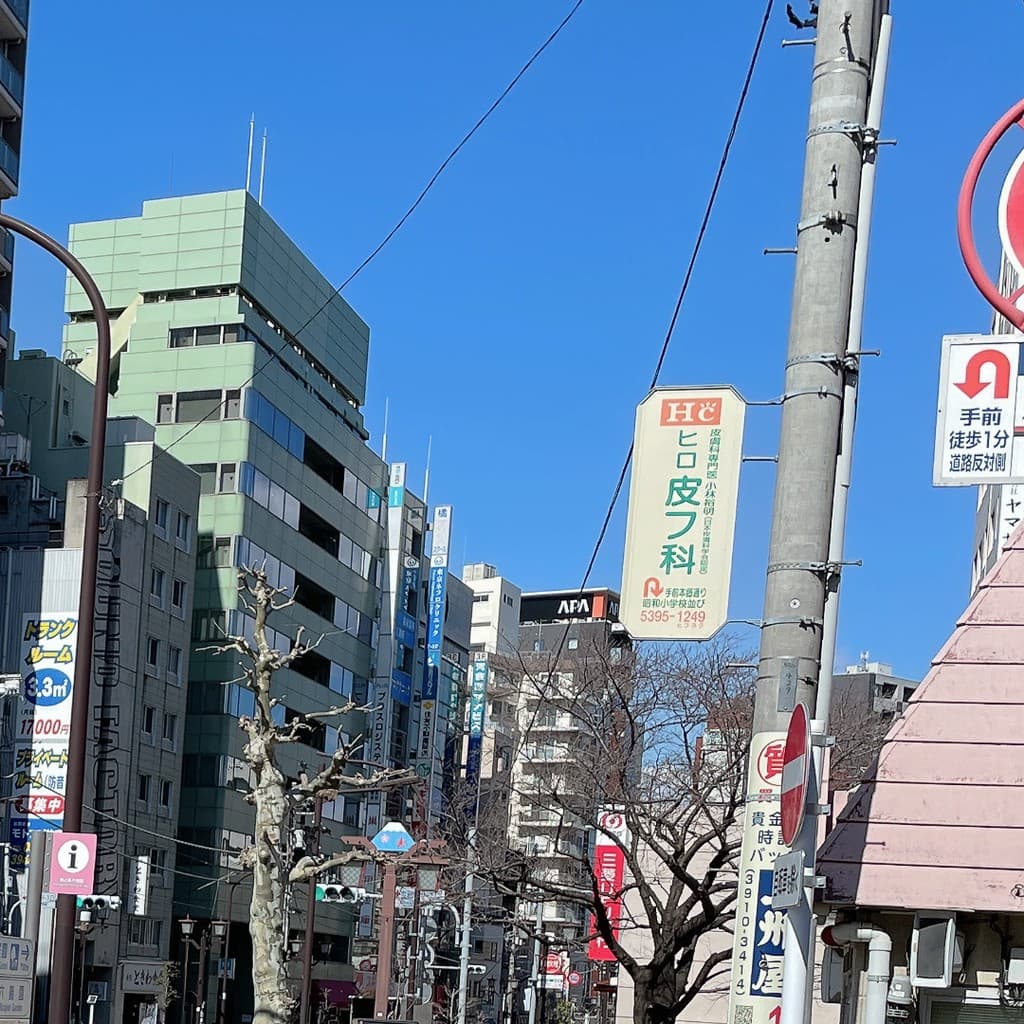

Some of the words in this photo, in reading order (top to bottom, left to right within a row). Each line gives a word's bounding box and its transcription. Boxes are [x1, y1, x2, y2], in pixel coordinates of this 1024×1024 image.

[960, 407, 1002, 426] 手前
[949, 430, 1009, 449] 徒歩1分
[949, 453, 1006, 473] 道路反対側
[660, 430, 702, 575] ヒロ皮フ科
[557, 599, 590, 614] APA
[640, 610, 706, 622] 5395-1249
[24, 618, 76, 641] トランク
[24, 645, 73, 665] ルーム
[752, 811, 783, 827] 貴金
[750, 847, 782, 863] バッ
[752, 894, 785, 994] 州屋
